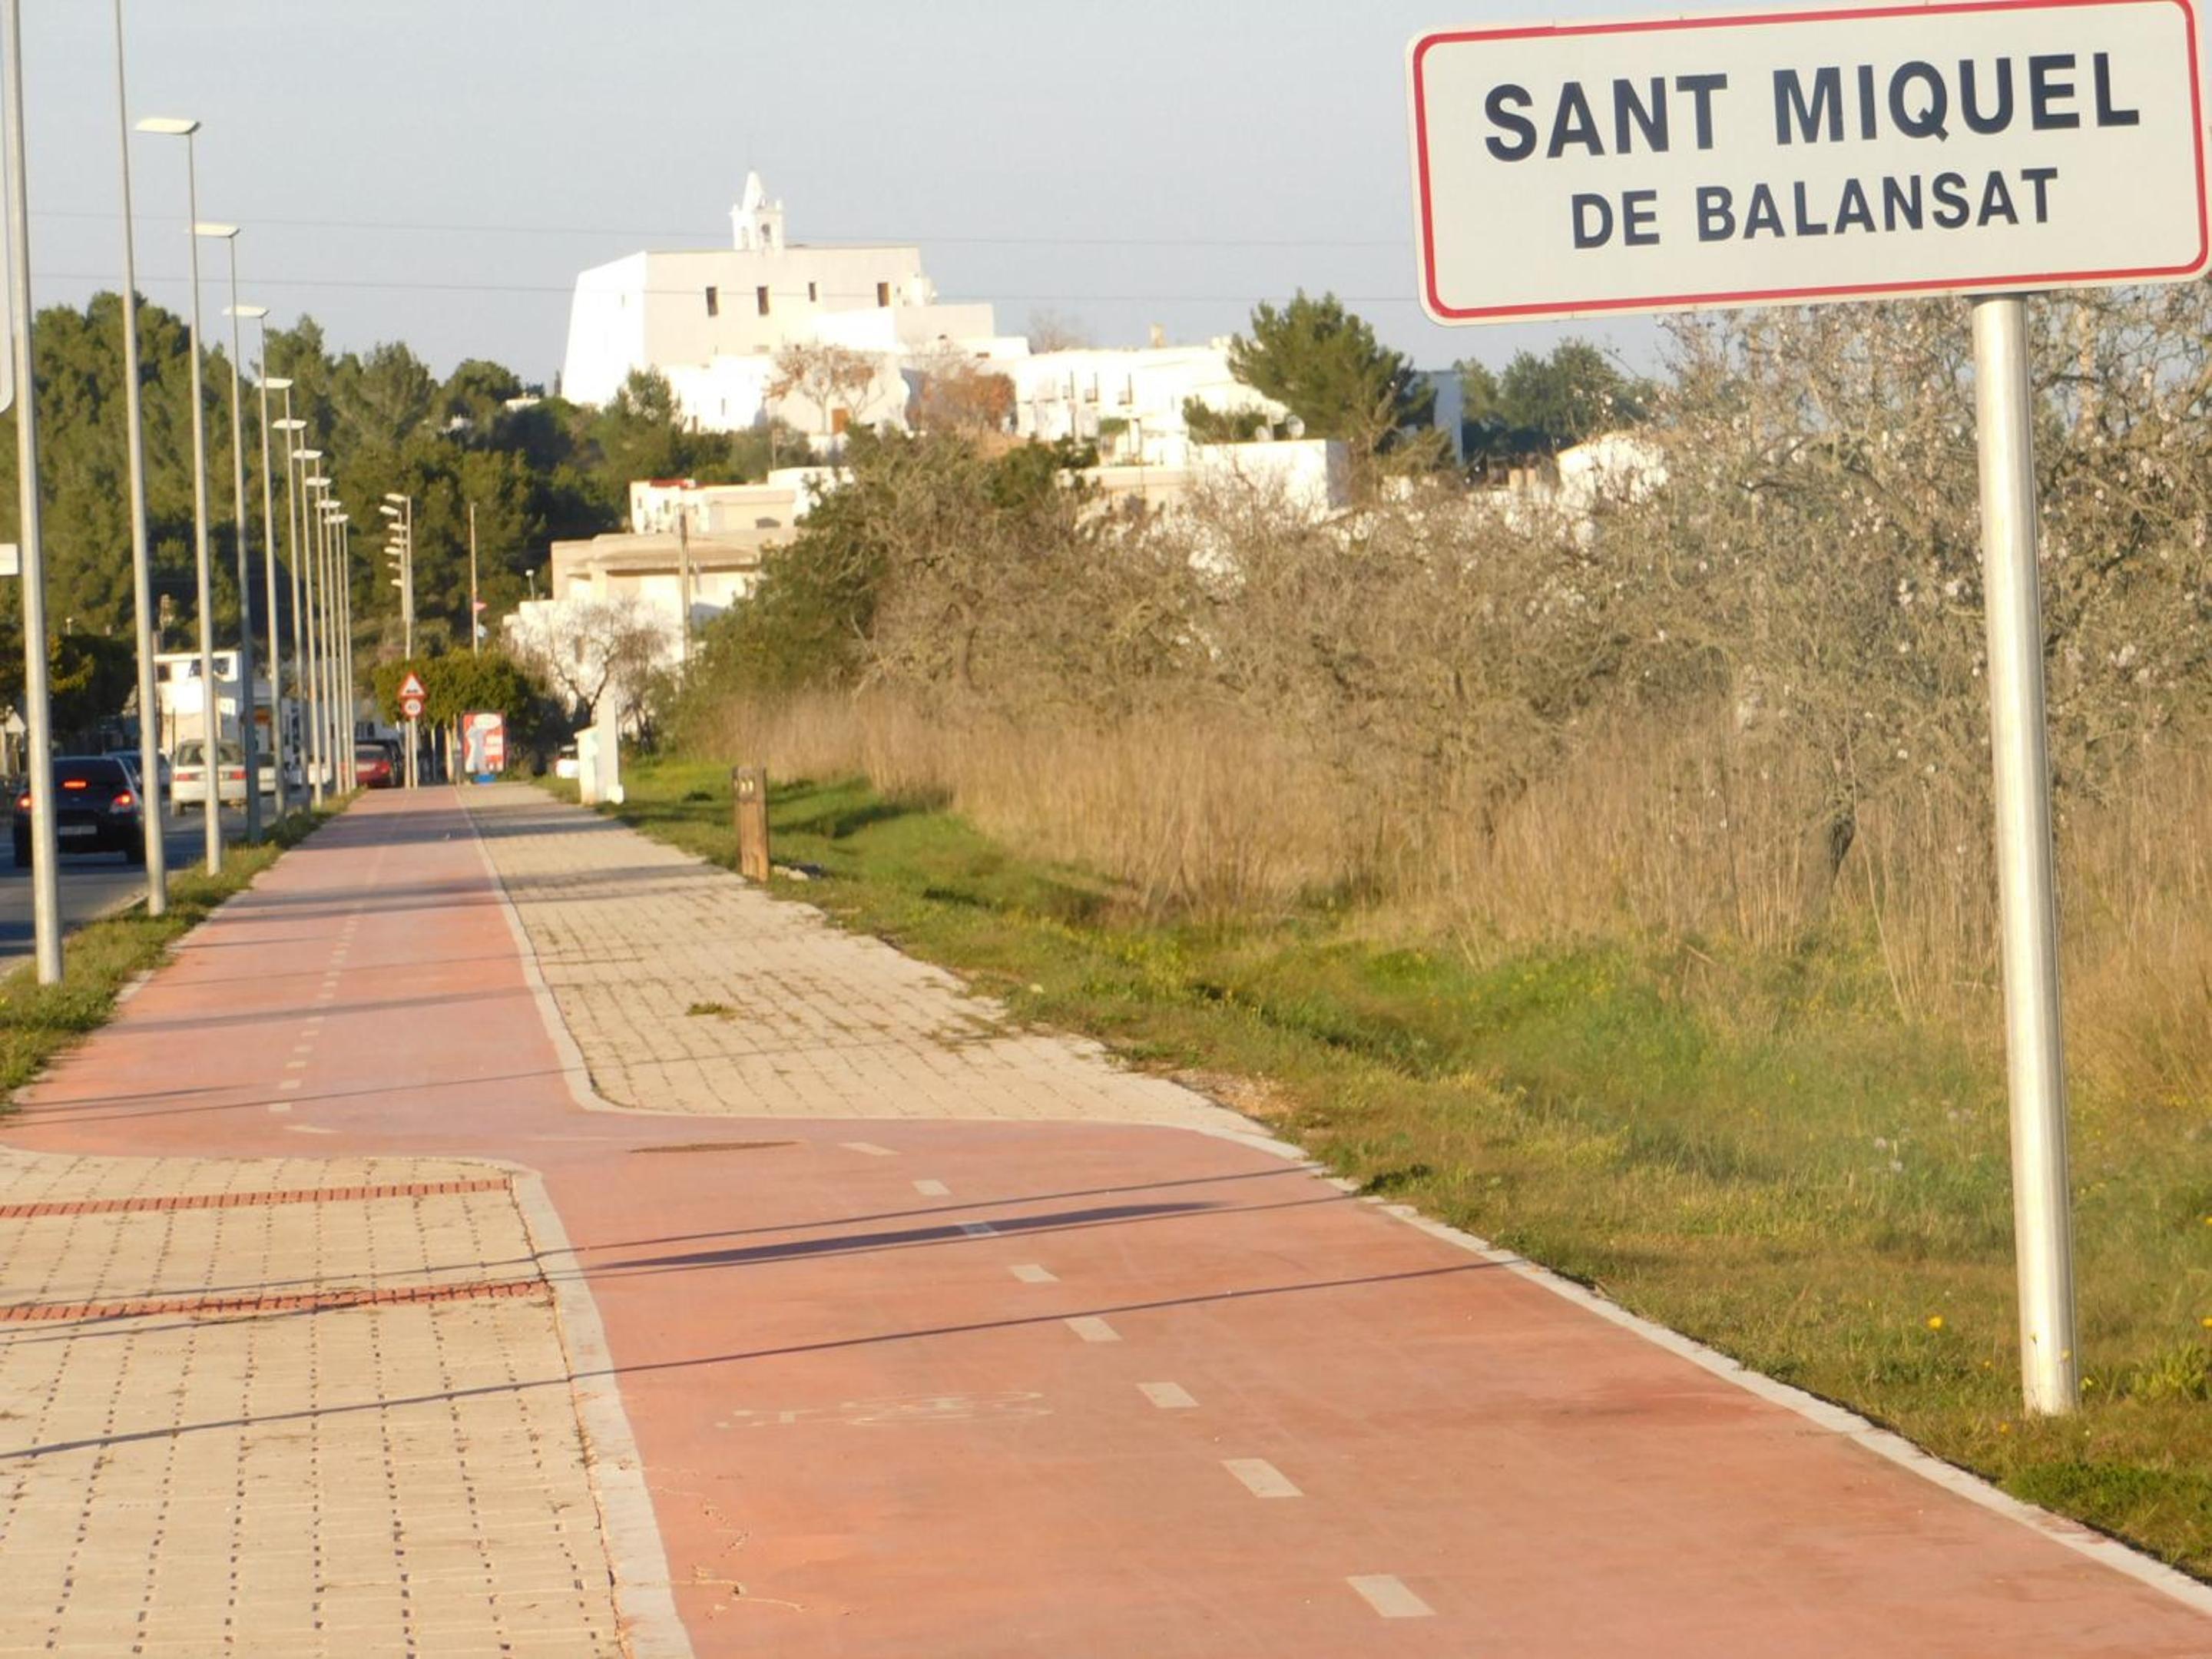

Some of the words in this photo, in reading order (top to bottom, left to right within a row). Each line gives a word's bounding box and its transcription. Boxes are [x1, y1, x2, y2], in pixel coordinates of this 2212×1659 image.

[1485, 73, 1727, 162] SANT
[1773, 52, 2140, 145] MIQUEL
[1571, 190, 1660, 249] DE
[1696, 167, 2058, 242] BALANSAT
